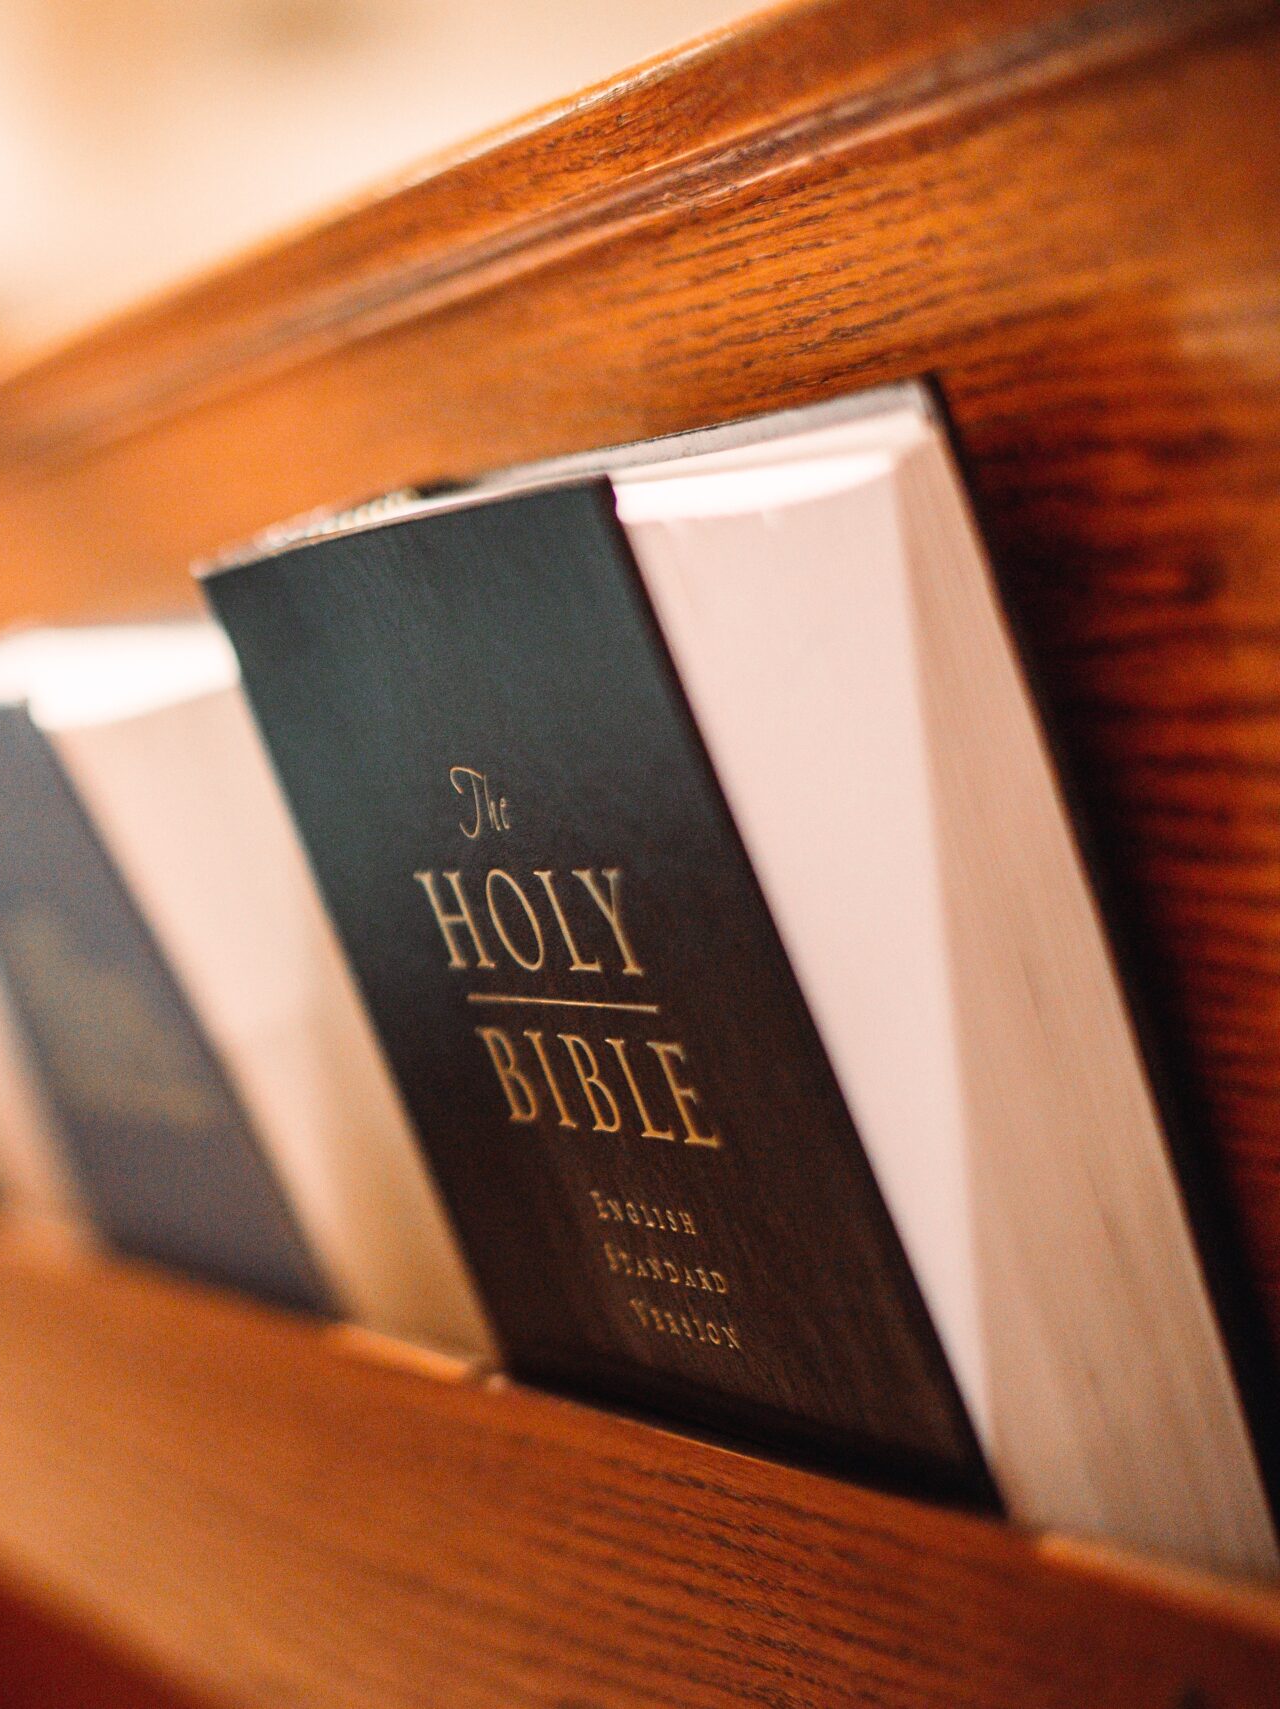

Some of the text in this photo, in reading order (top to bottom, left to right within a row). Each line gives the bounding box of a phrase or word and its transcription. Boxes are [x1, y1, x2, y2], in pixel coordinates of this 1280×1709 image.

[449, 766, 511, 838] The
[413, 868, 645, 976] HOLY
[474, 1025, 721, 1149] BIBLE
